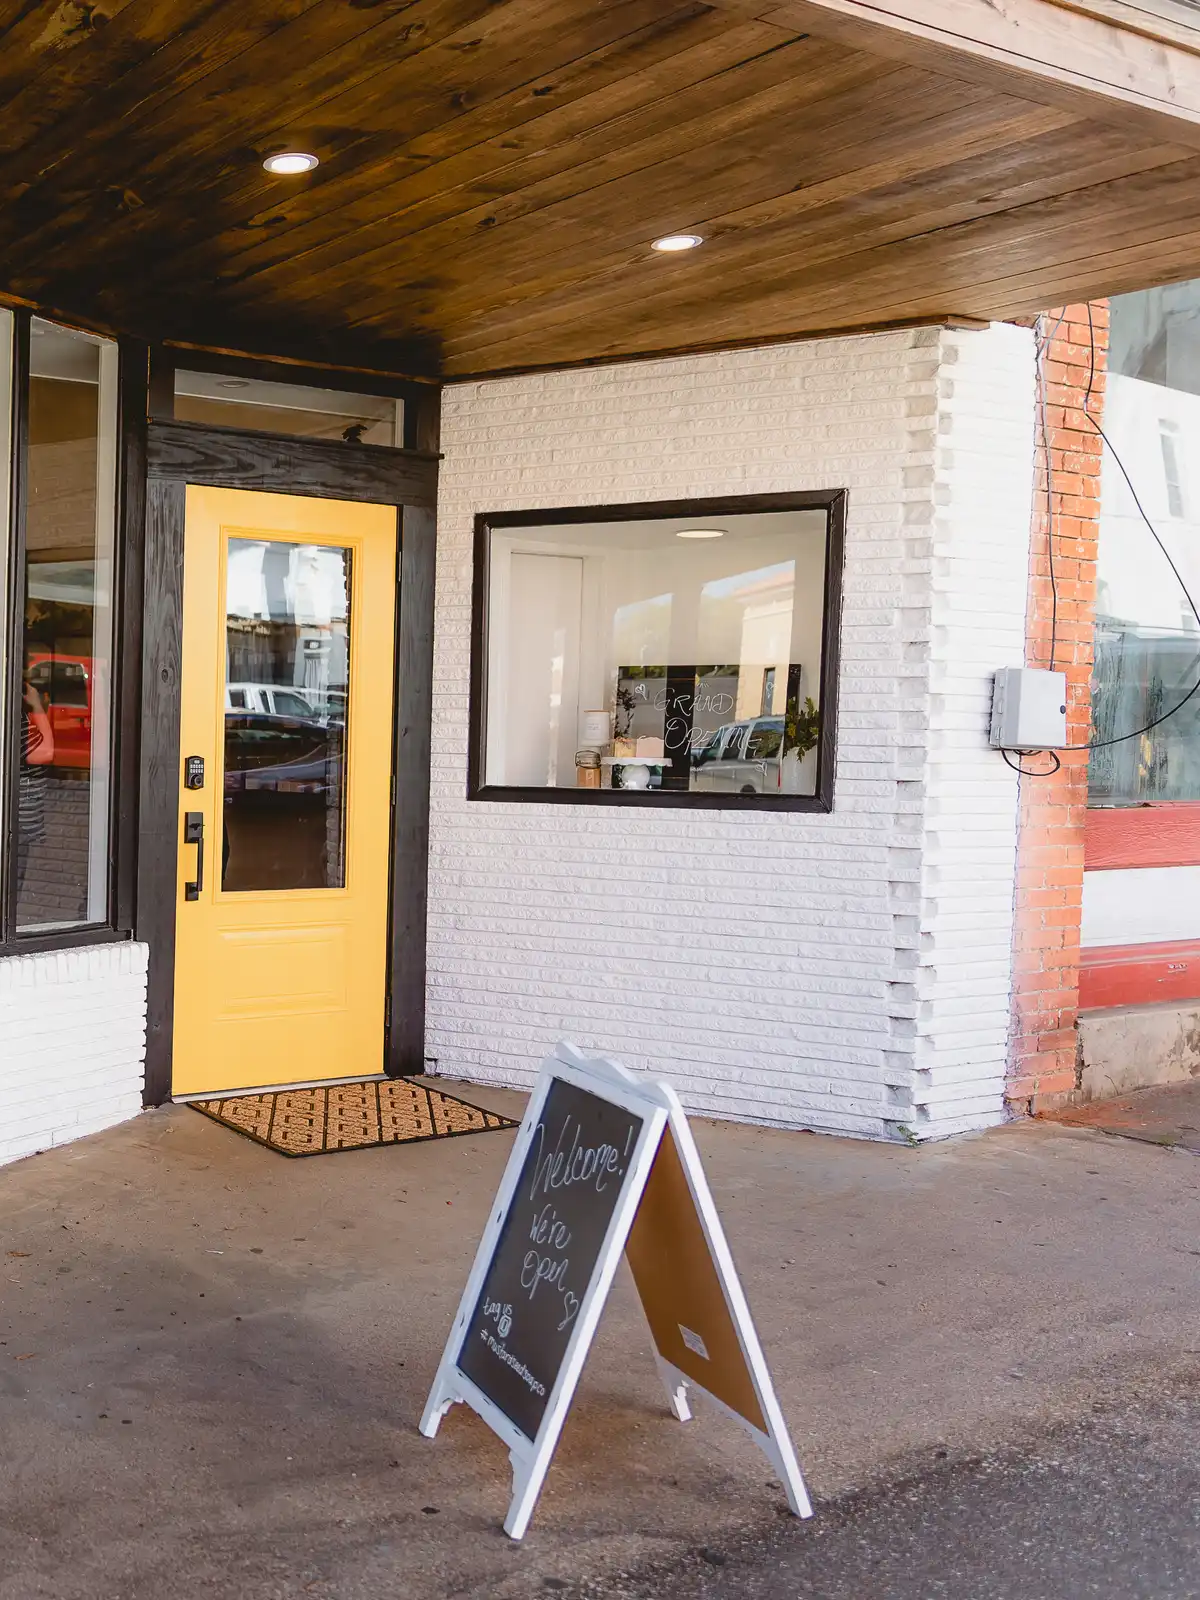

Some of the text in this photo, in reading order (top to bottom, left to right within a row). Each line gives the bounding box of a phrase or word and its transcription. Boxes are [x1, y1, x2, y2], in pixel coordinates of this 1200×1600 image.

[653, 687, 735, 717] GRAND
[530, 1114, 635, 1201] Welcome!
[519, 1250, 569, 1300] Open
[483, 1297, 500, 1322] tag
